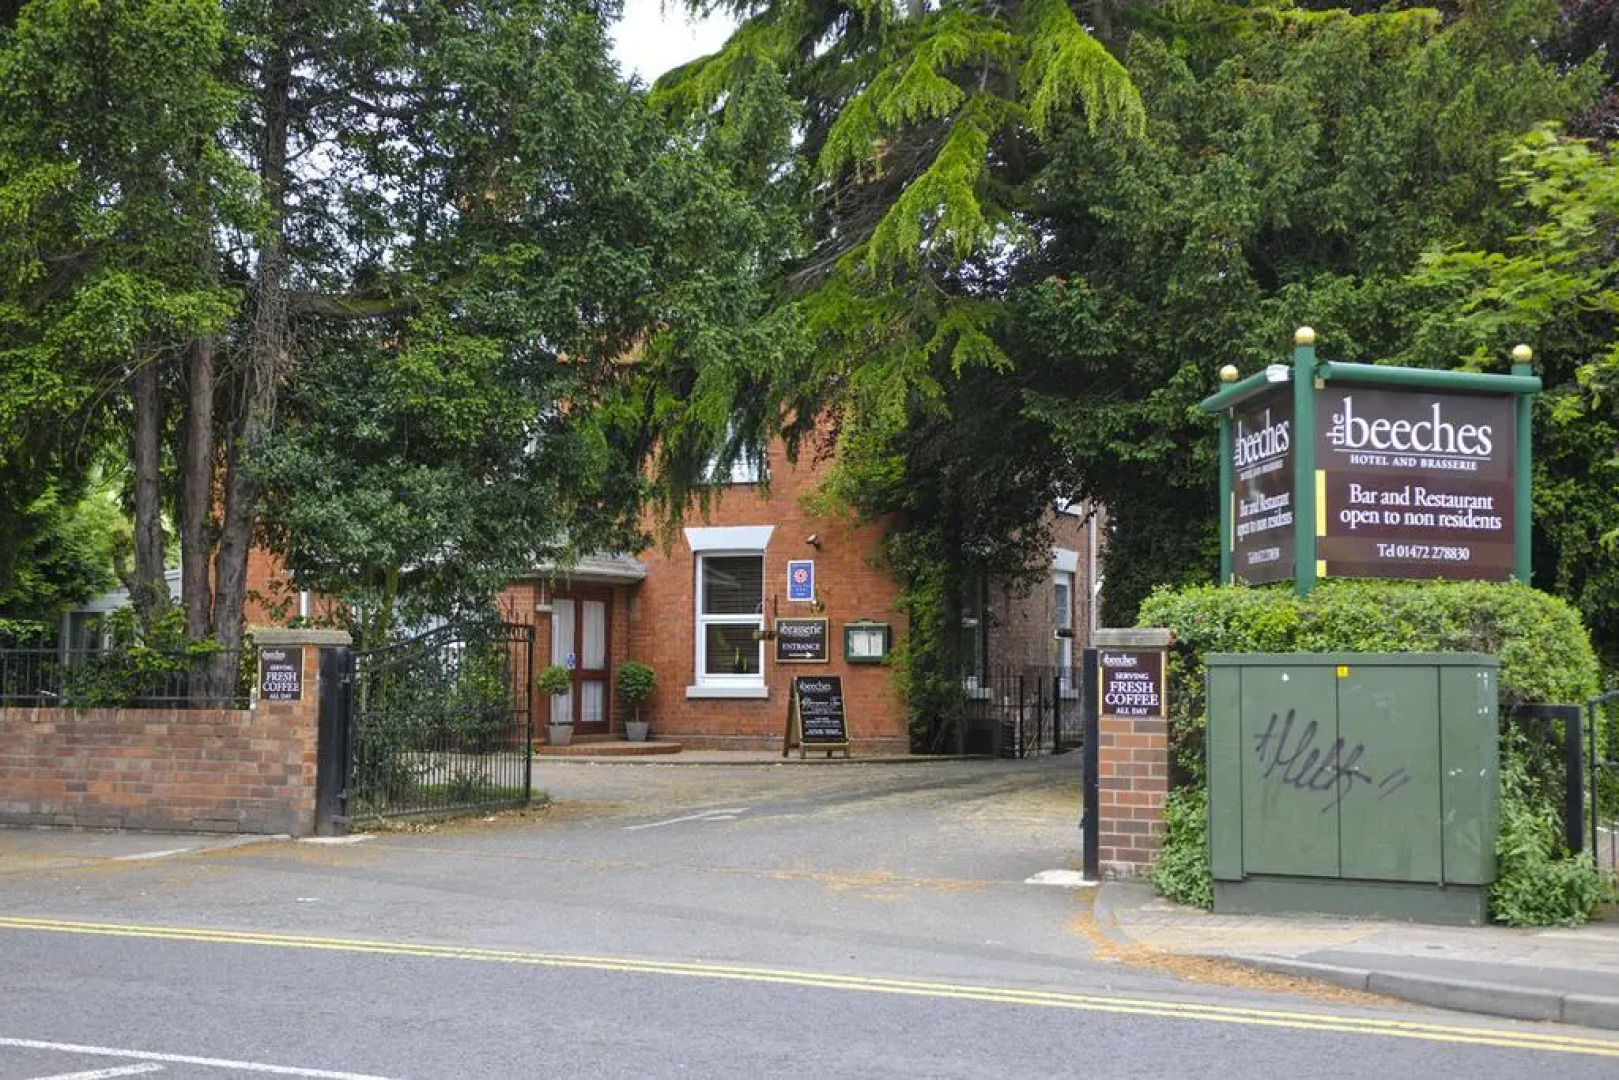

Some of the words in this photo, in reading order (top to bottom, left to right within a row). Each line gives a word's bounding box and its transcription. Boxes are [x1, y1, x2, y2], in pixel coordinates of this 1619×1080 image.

[1326, 413, 1345, 445] the
[1344, 397, 1492, 455] beeches
[1238, 408, 1289, 465] beeches
[1350, 455, 1388, 466] HOTEL
[1392, 457, 1417, 467] AND
[1420, 458, 1478, 470] BRASSERIE
[1349, 483, 1378, 503] Bar
[1380, 485, 1410, 506] and
[1414, 487, 1493, 510] Restaurant
[1340, 509, 1379, 529] open
[1384, 511, 1400, 525] to
[1404, 513, 1435, 526] non
[1439, 509, 1503, 529] residents
[1377, 543, 1396, 557] Tel
[1396, 544, 1430, 559] 01472
[1432, 546, 1470, 561] 278830
[782, 643, 821, 651] ENTRANCE
[266, 671, 296, 681] FRESH
[262, 682, 299, 692] COFFEE
[1110, 681, 1154, 693] FRESH
[1104, 693, 1159, 706] COFFEE
